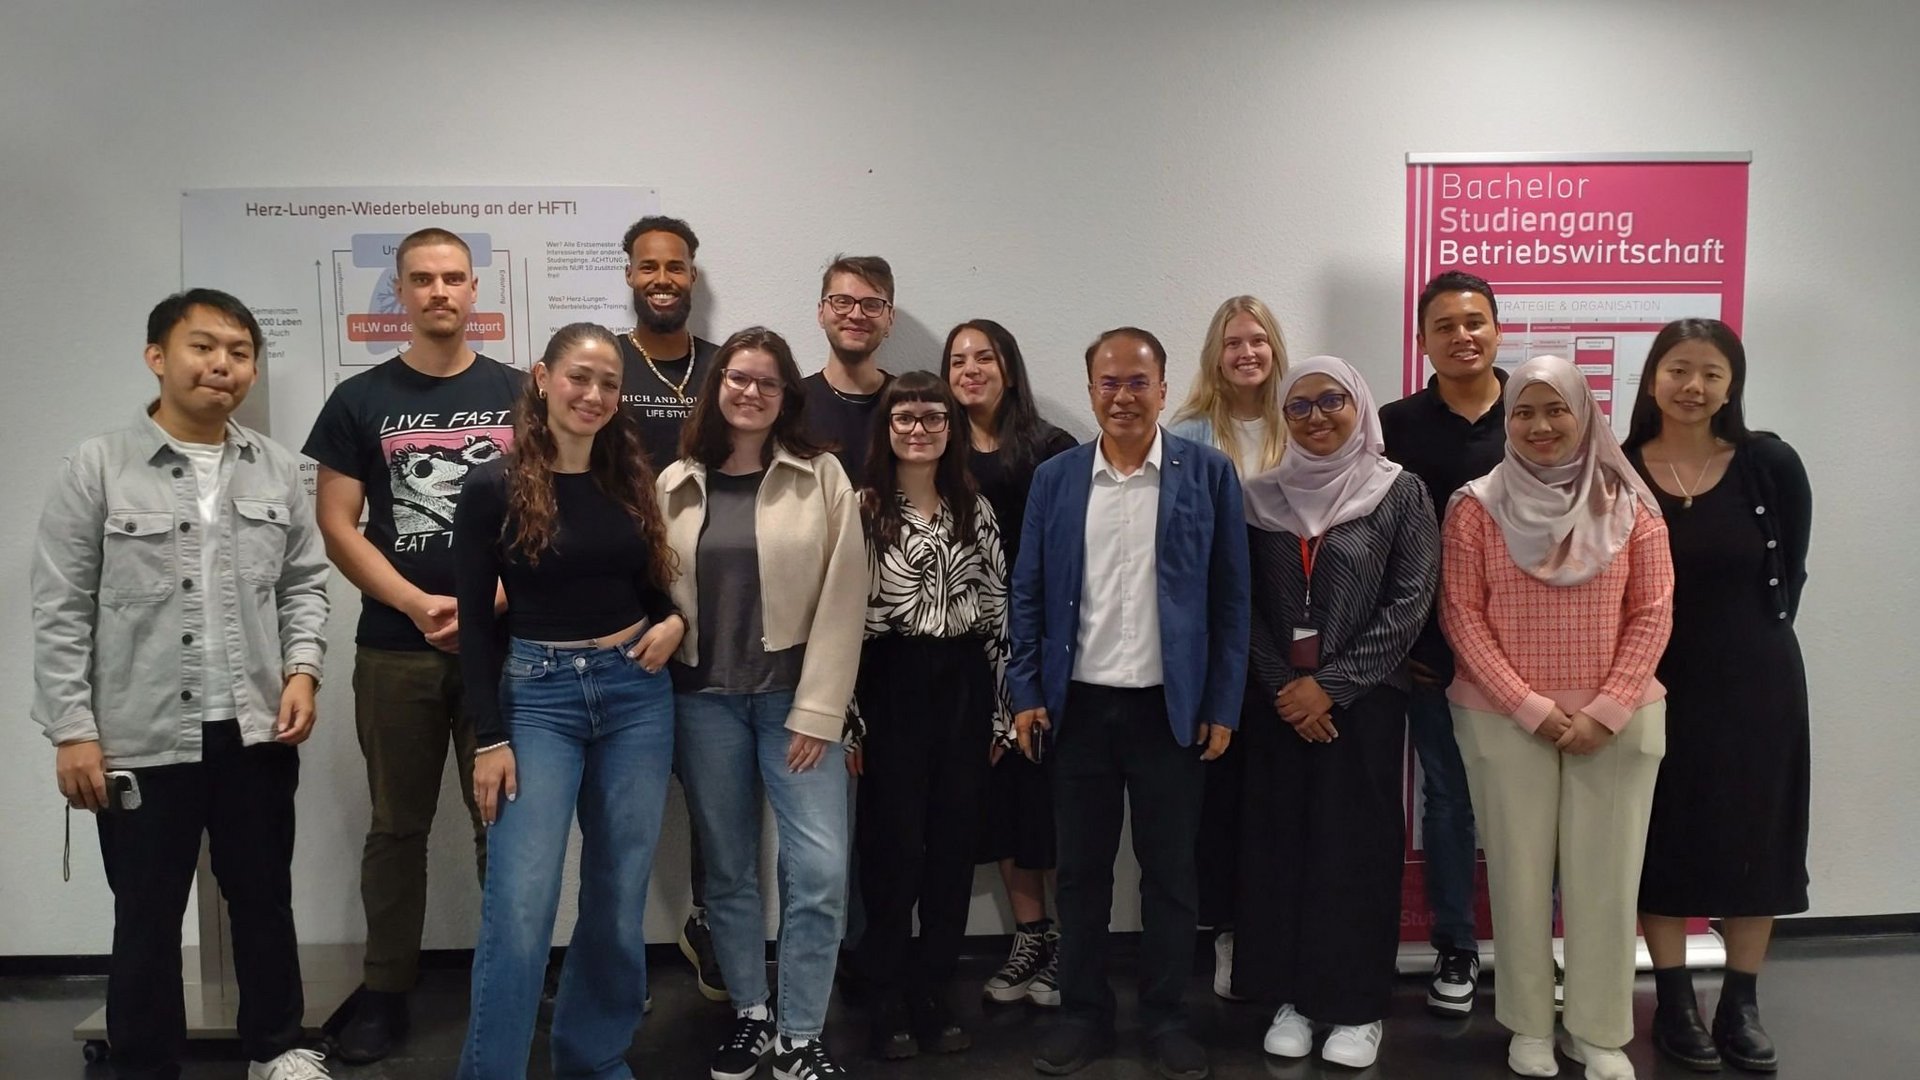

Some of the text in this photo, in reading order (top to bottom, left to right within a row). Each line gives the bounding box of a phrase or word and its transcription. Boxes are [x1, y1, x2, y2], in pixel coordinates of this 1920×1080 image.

[1442, 171, 1590, 200] Bachelor
[246, 201, 577, 219] Herz-Lungen-Wiederbelebung an der HFT!
[1440, 206, 1634, 239] Studiengang
[1439, 238, 1725, 265] Betriebswirtschaft
[591, 256, 623, 264] ACHTUNG
[1496, 300, 1661, 311] TRATEGIE & ORGANISATION
[258, 318, 302, 326] 000 Leben
[352, 321, 502, 334] HLW an de uttgart
[268, 329, 290, 337] Auch
[654, 396, 677, 404] AND
[646, 409, 665, 418] LIFE
[380, 410, 511, 434] LIVE FAST
[394, 533, 435, 552] EAT
[1400, 910, 1436, 926] Stut
